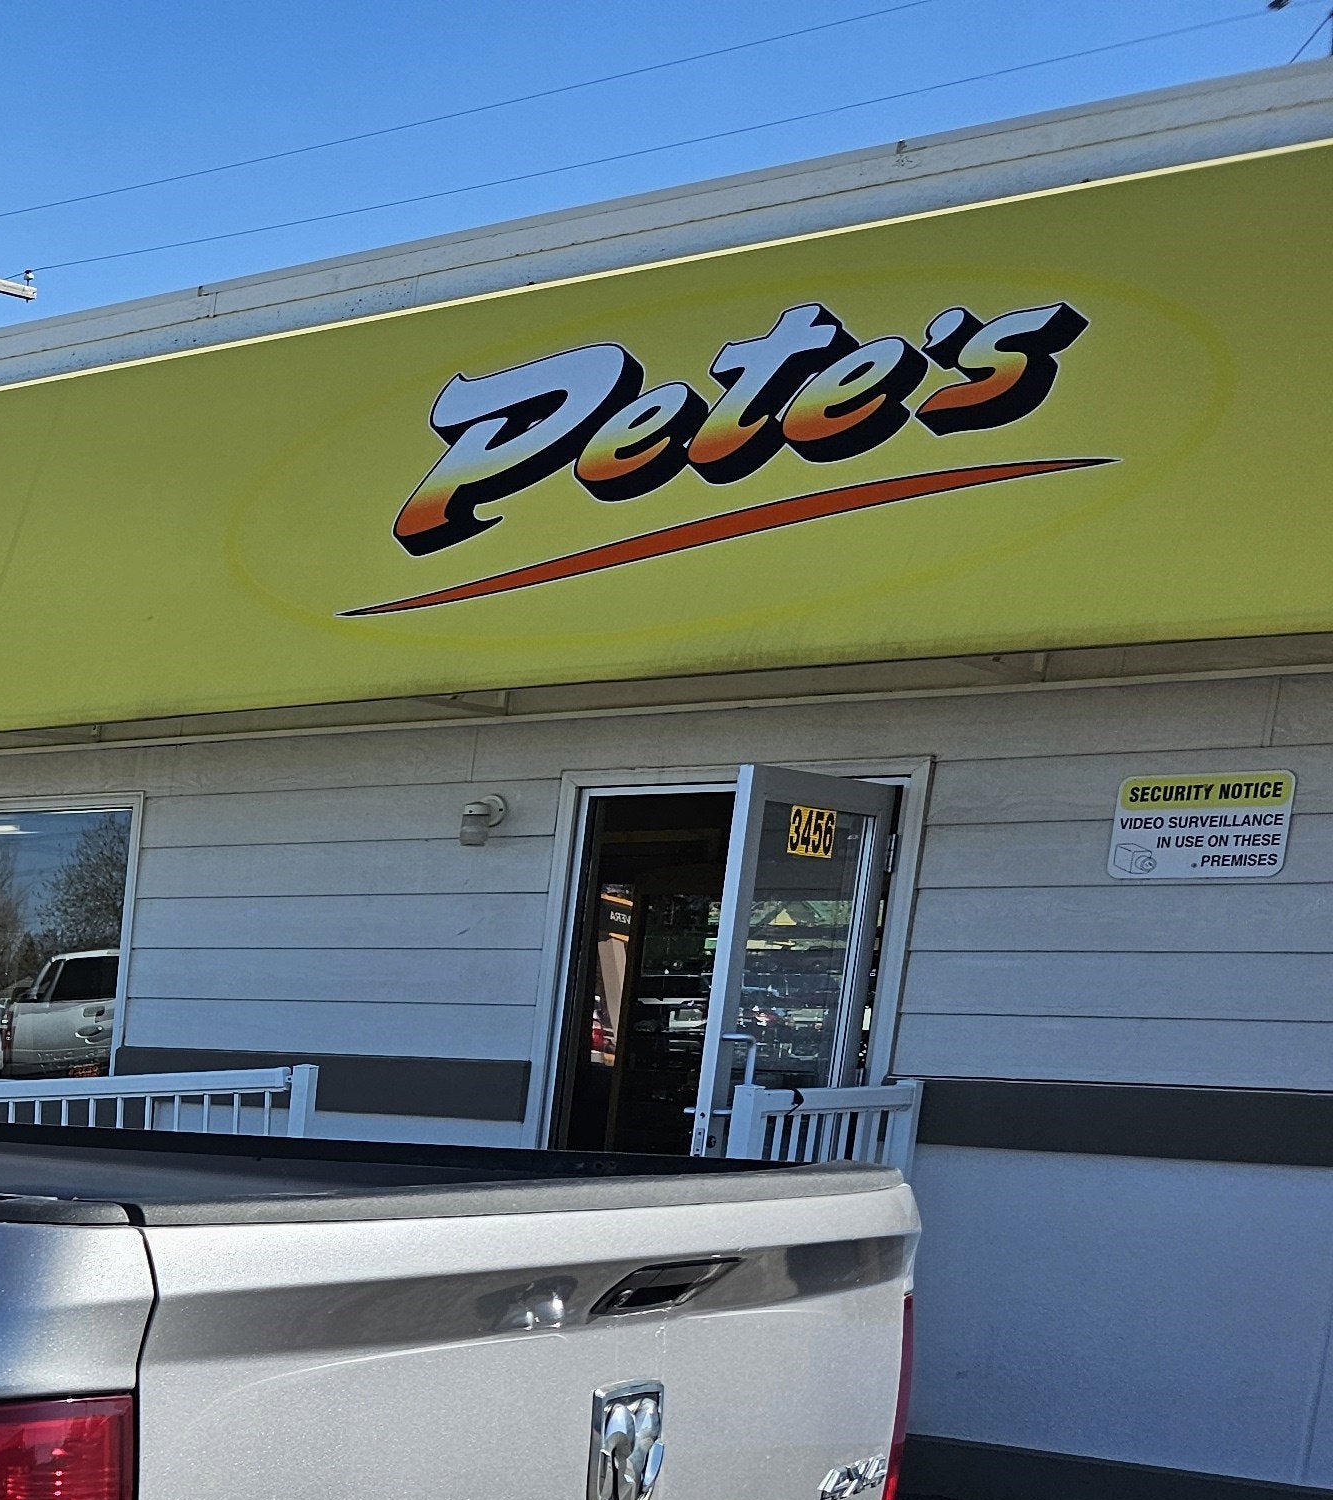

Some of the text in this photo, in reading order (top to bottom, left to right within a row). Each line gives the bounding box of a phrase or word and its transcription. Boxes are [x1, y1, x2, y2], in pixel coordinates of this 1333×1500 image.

[393, 302, 1089, 557] Pete's
[1129, 781, 1284, 803] SECURITY NOTICE
[1120, 813, 1284, 830] VIDEO SURVEILLANCE
[789, 808, 834, 856] 3456
[1156, 833, 1281, 849] IN USE ON THESE
[1200, 853, 1278, 868] PREMISES
